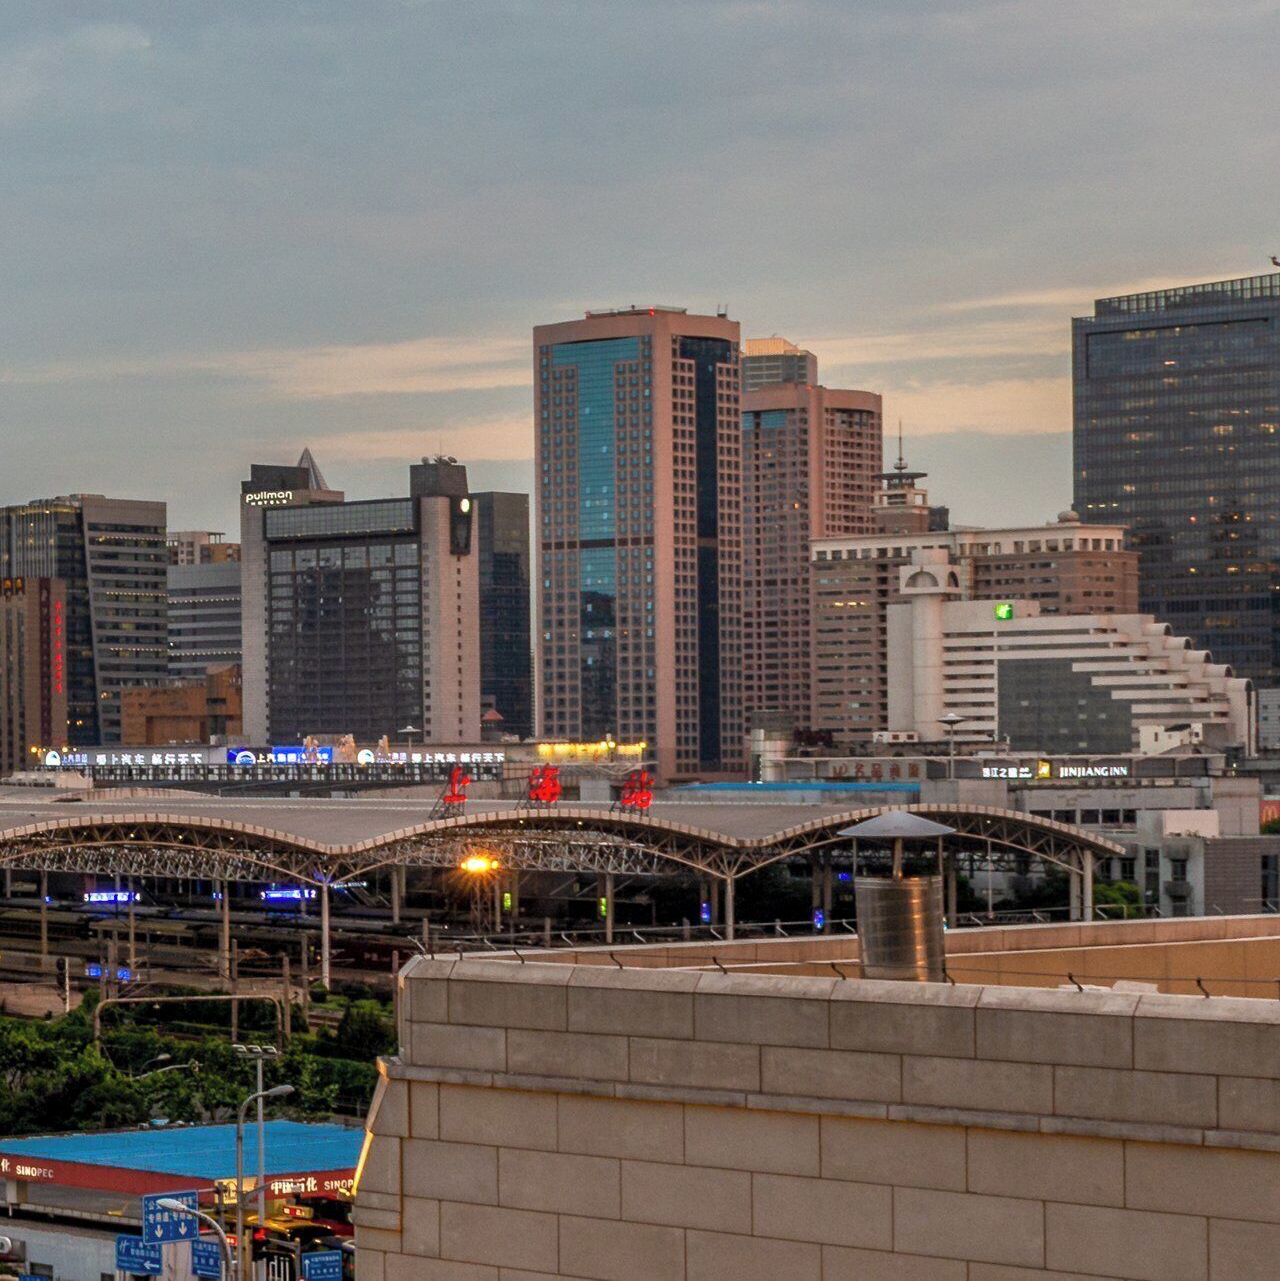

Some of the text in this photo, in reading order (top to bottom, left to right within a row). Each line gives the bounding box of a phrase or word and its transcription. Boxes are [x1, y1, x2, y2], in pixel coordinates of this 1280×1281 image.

[245, 490, 293, 503] pullman
[1059, 766, 1128, 778] JINJIANG INN
[16, 1165, 54, 1178] SINOPEC
